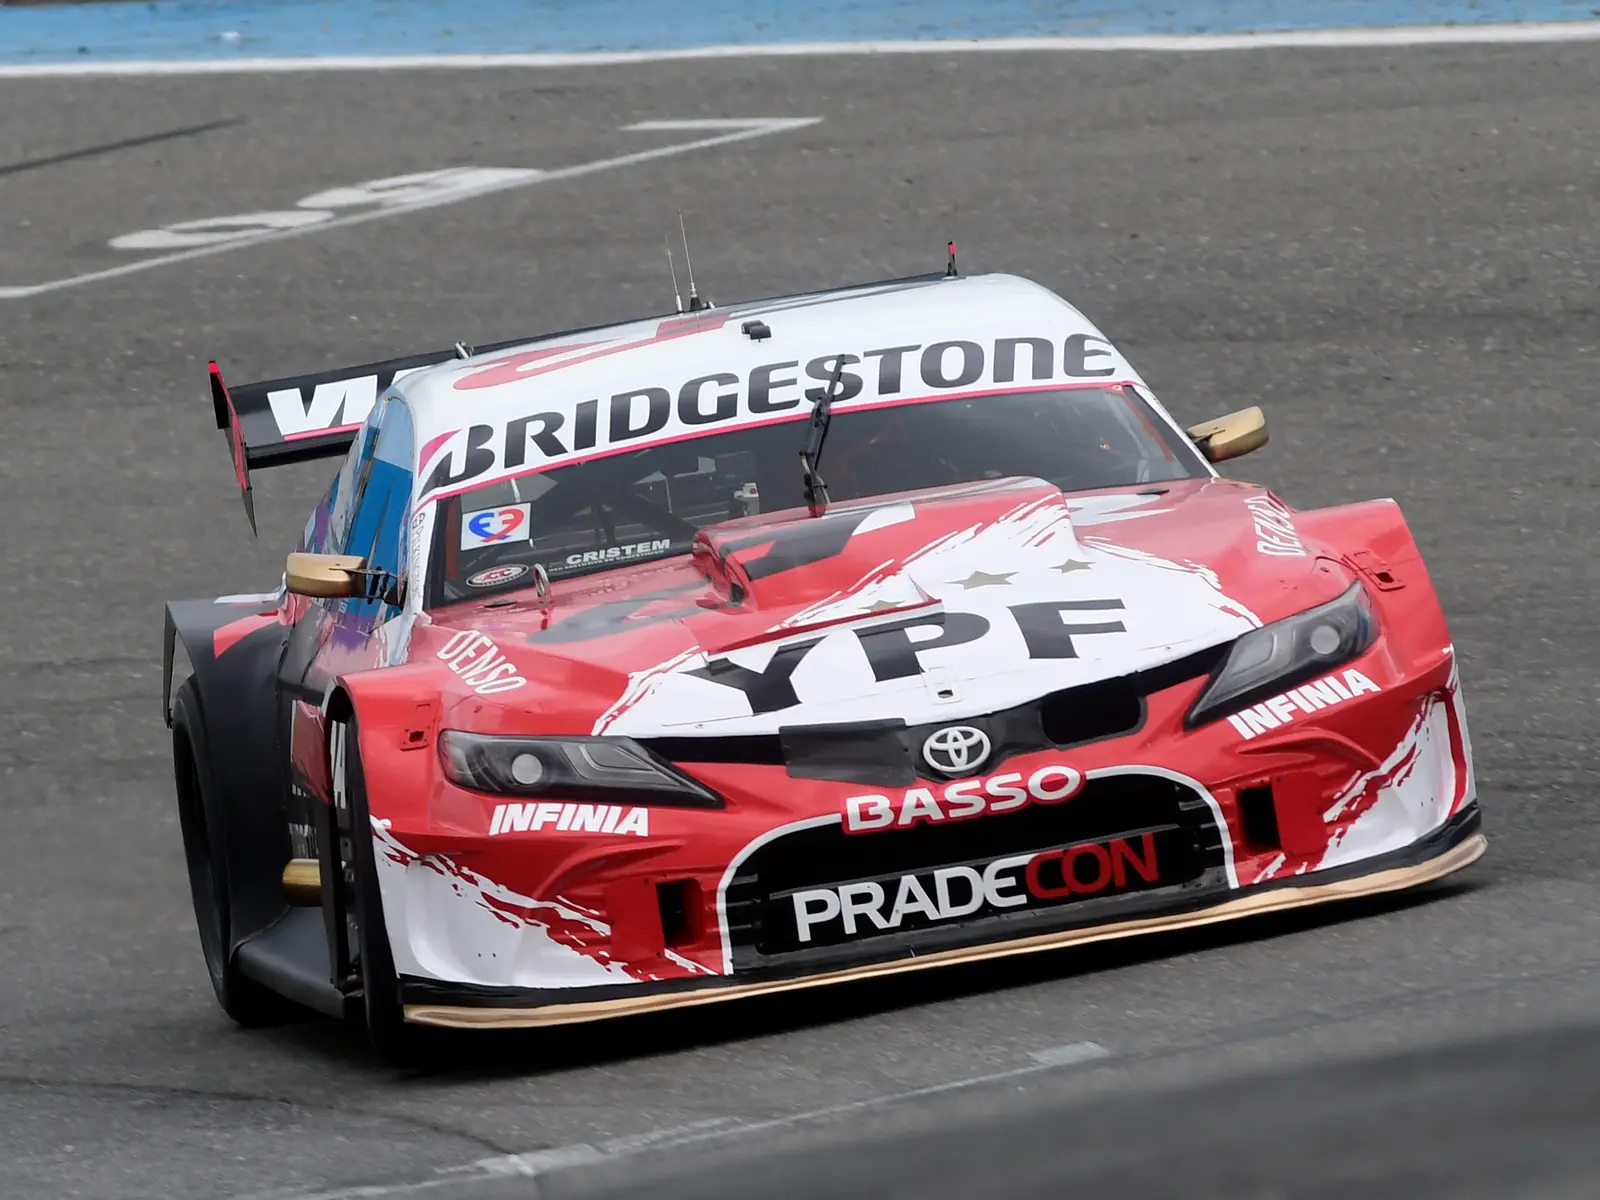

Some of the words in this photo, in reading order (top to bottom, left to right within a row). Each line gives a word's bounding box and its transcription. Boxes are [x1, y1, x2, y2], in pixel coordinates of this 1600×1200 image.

[417, 333, 1117, 500] BRIDGESTONE
[566, 539, 670, 564] CRISTEM
[1244, 495, 1306, 556] DENSO
[436, 630, 527, 695] DENSO
[678, 598, 1126, 714] YPF
[1226, 668, 1382, 740] INFINIA
[489, 803, 650, 837] INFINIA
[845, 765, 1083, 832] BASSO
[791, 832, 1160, 942] PRADECON
